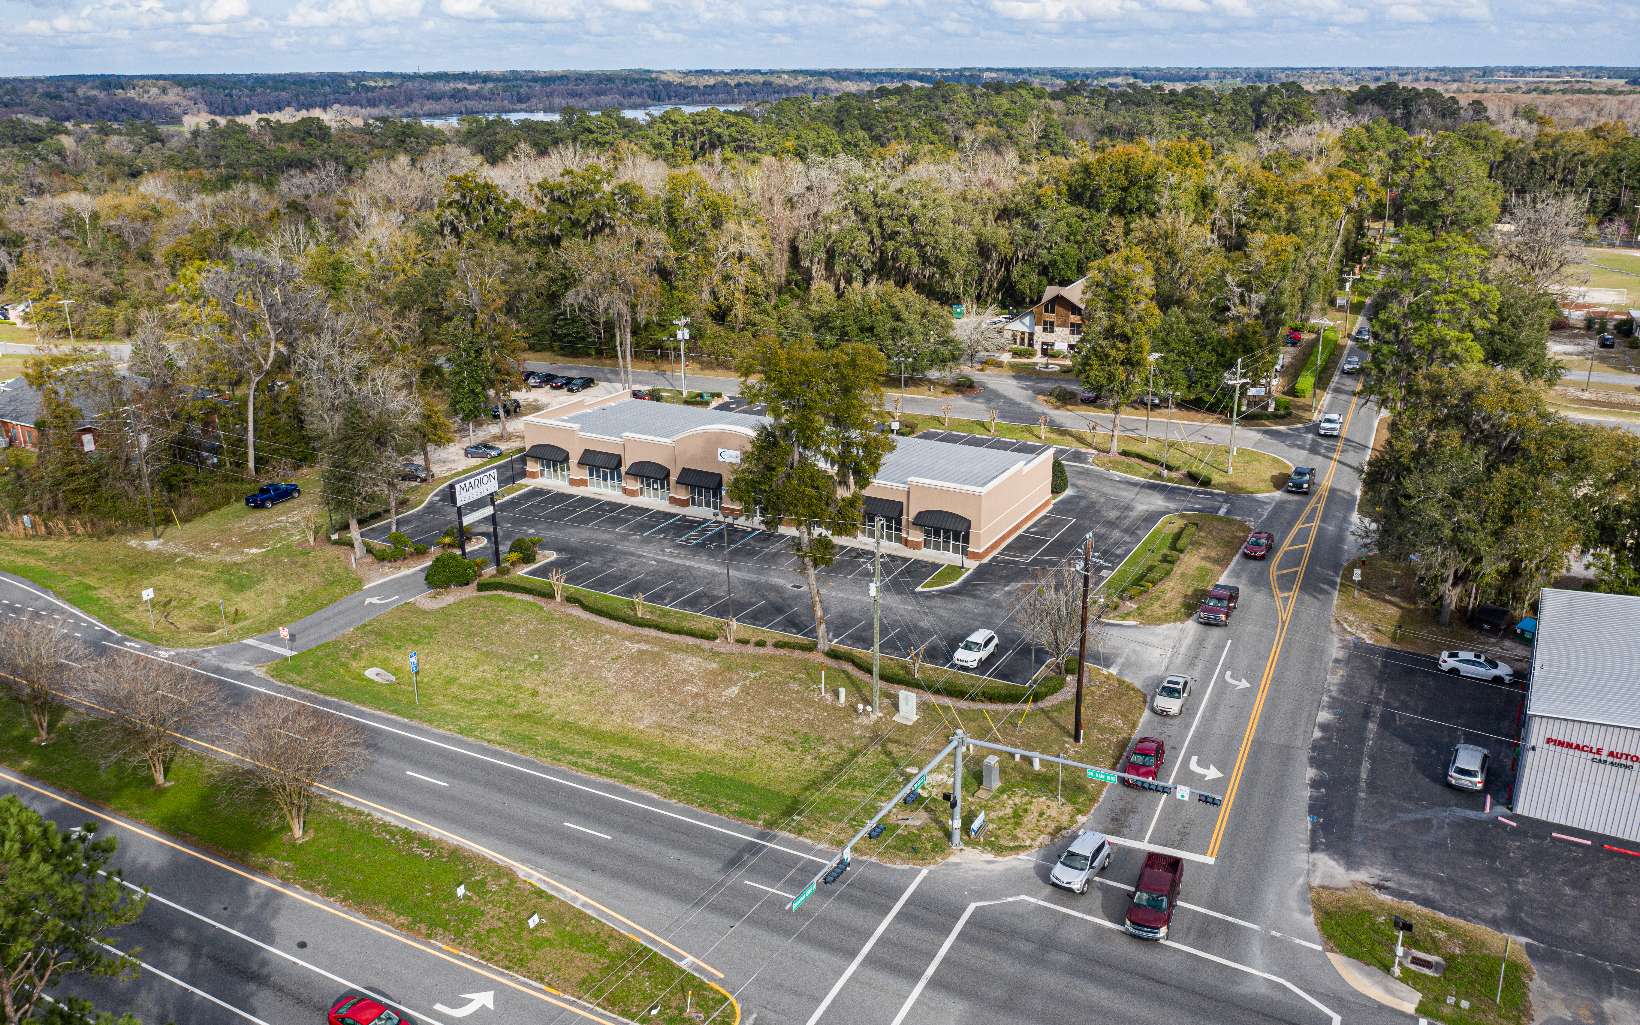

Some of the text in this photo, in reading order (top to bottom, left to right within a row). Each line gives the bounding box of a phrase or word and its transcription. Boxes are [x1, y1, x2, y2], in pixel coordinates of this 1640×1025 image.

[459, 471, 496, 495] MARION
[1545, 737, 1604, 755] PINNACLE
[1591, 757, 1633, 771] CAR AUDIO
